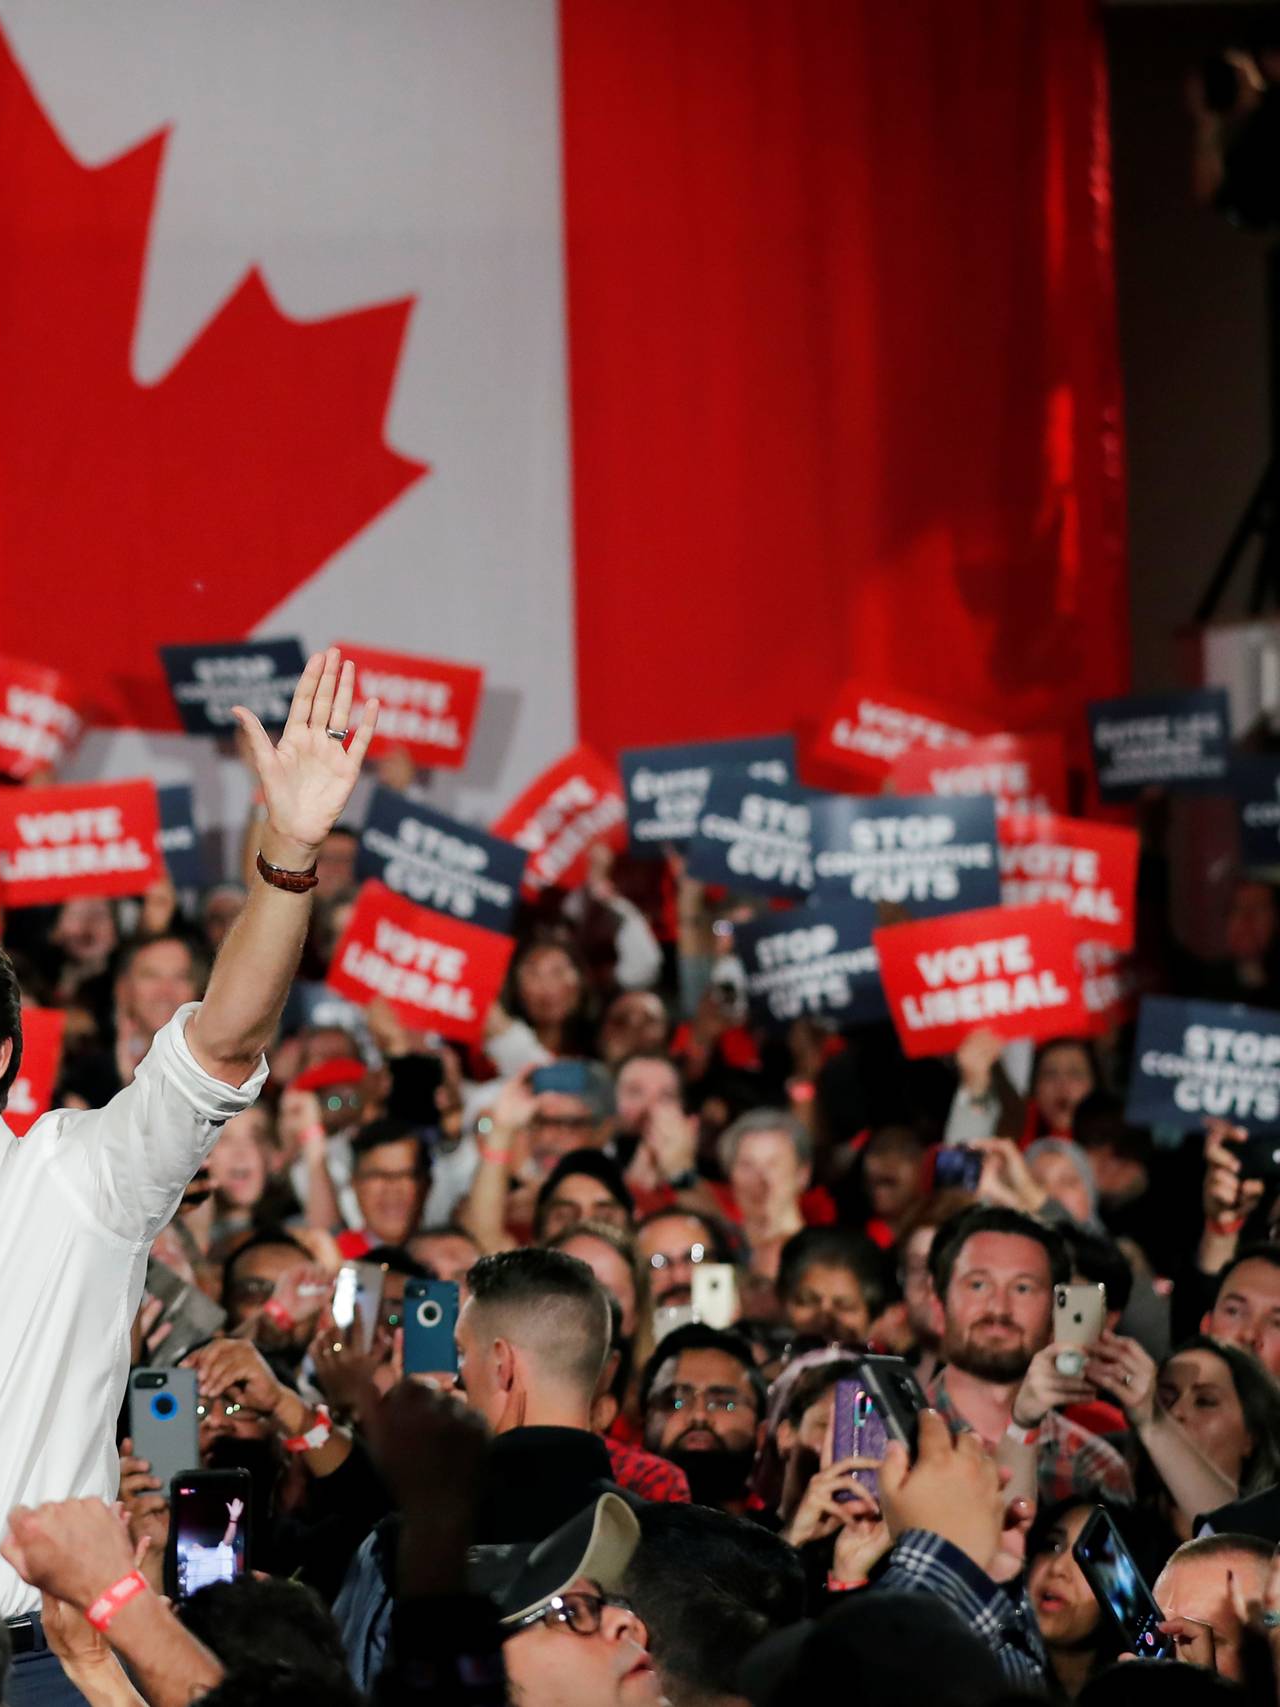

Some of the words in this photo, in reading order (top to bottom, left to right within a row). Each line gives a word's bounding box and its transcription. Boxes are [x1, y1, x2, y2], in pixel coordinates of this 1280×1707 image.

[361, 671, 452, 712] VOTE
[16, 806, 122, 845] VOTE
[398, 816, 489, 875] STOP
[850, 815, 957, 850] STOP
[852, 867, 961, 902] CUTS
[374, 918, 468, 983] VOTE
[915, 934, 1033, 988] VOTE
[341, 942, 477, 1021] LIBERAL
[902, 970, 1069, 1031] LIBERAL
[1173, 1078, 1280, 1122] CUTS
